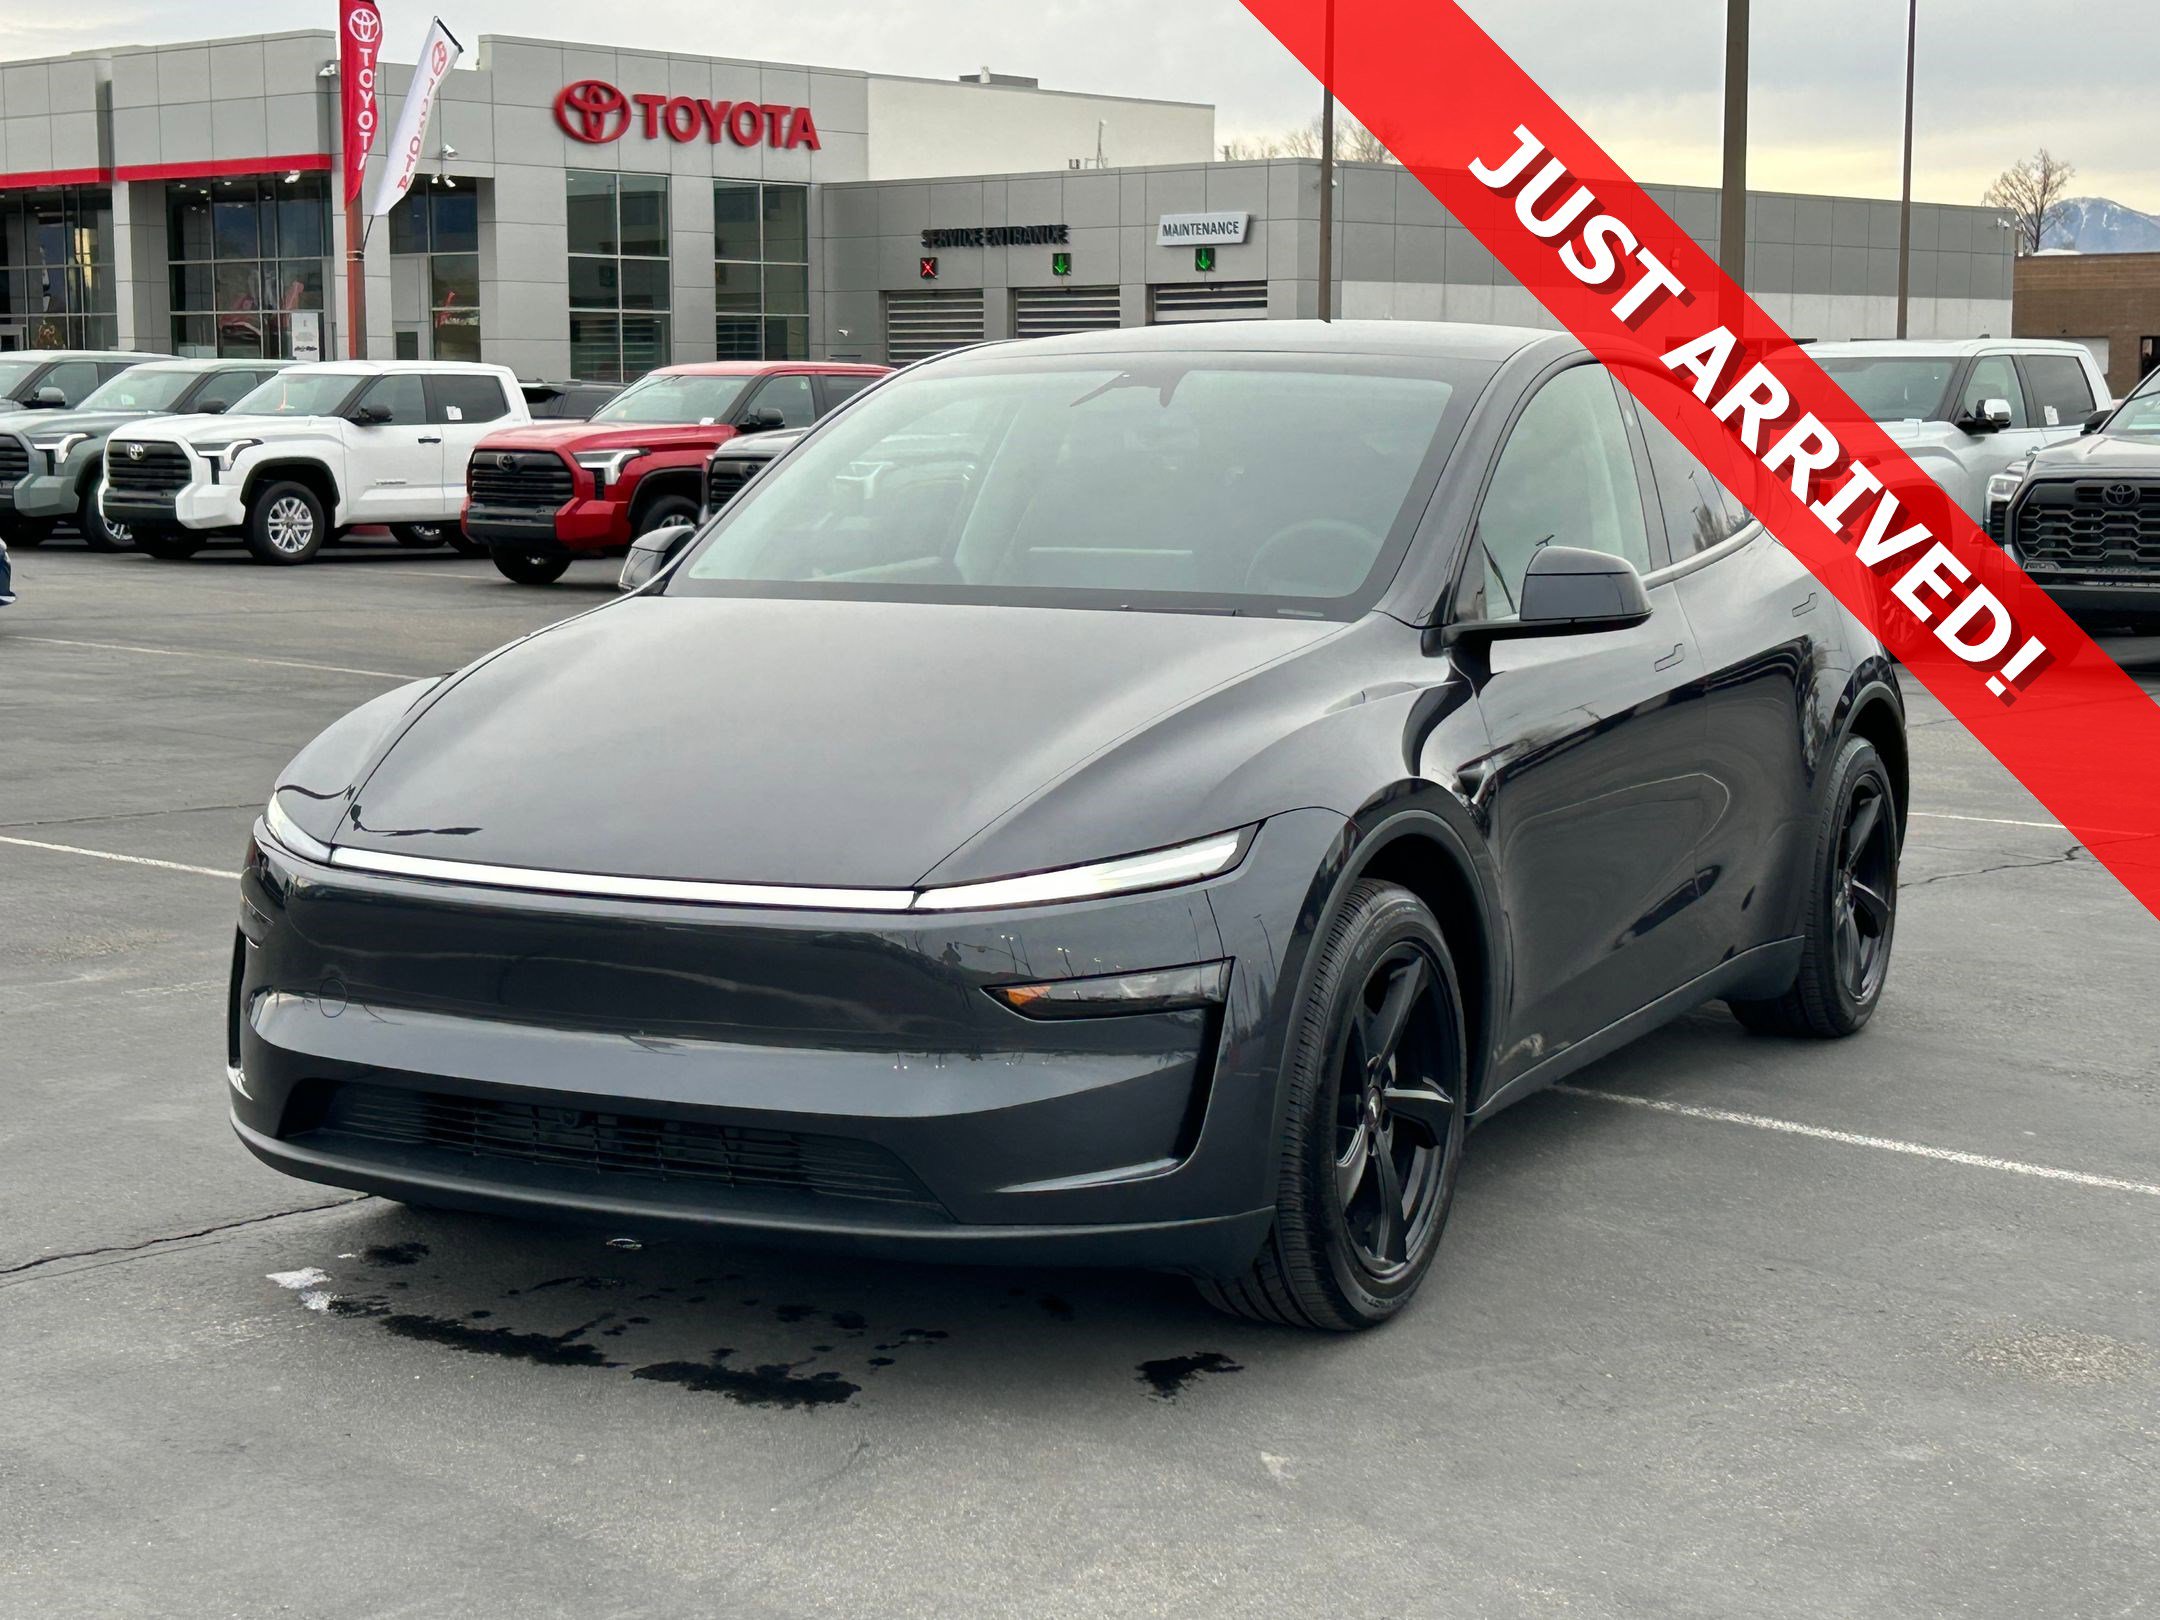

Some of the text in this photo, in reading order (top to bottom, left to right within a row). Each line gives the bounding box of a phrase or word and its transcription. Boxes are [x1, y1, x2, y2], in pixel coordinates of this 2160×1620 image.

[397, 78, 435, 191] TOTA
[633, 93, 822, 151] TOYOTA
[920, 224, 1070, 248] SERVICE ENTRANCE
[1161, 221, 1240, 238] MAINTENANCE
